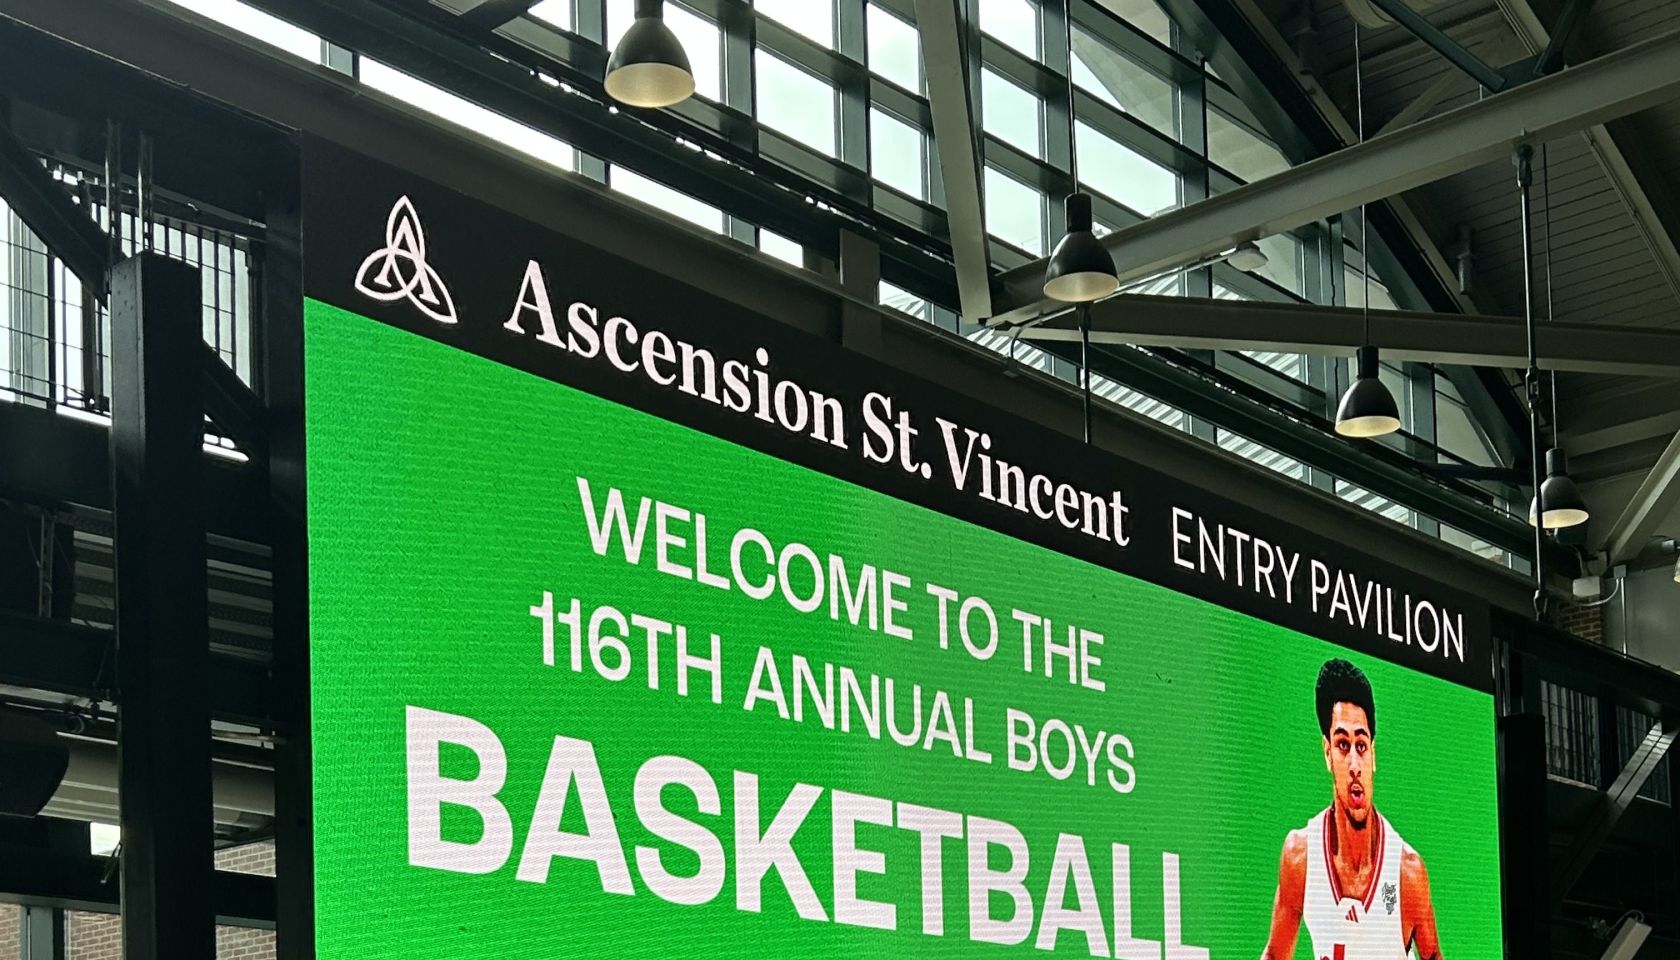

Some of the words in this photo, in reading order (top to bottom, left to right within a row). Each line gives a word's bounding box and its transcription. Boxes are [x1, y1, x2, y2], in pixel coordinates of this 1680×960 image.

[503, 259, 849, 450] Ascension
[862, 392, 932, 480] St.
[935, 416, 1130, 547] Vincent
[1172, 506, 1300, 604] ENTRY
[1310, 559, 1464, 663] PAVILION
[529, 590, 723, 705] 116TH
[743, 645, 993, 764] ANNUAL
[1006, 707, 1136, 794] BOYS
[575, 476, 914, 641] WELCOME
[926, 582, 999, 661] TO
[1011, 607, 1106, 693] THE
[405, 704, 1211, 960] BASKETBALL
